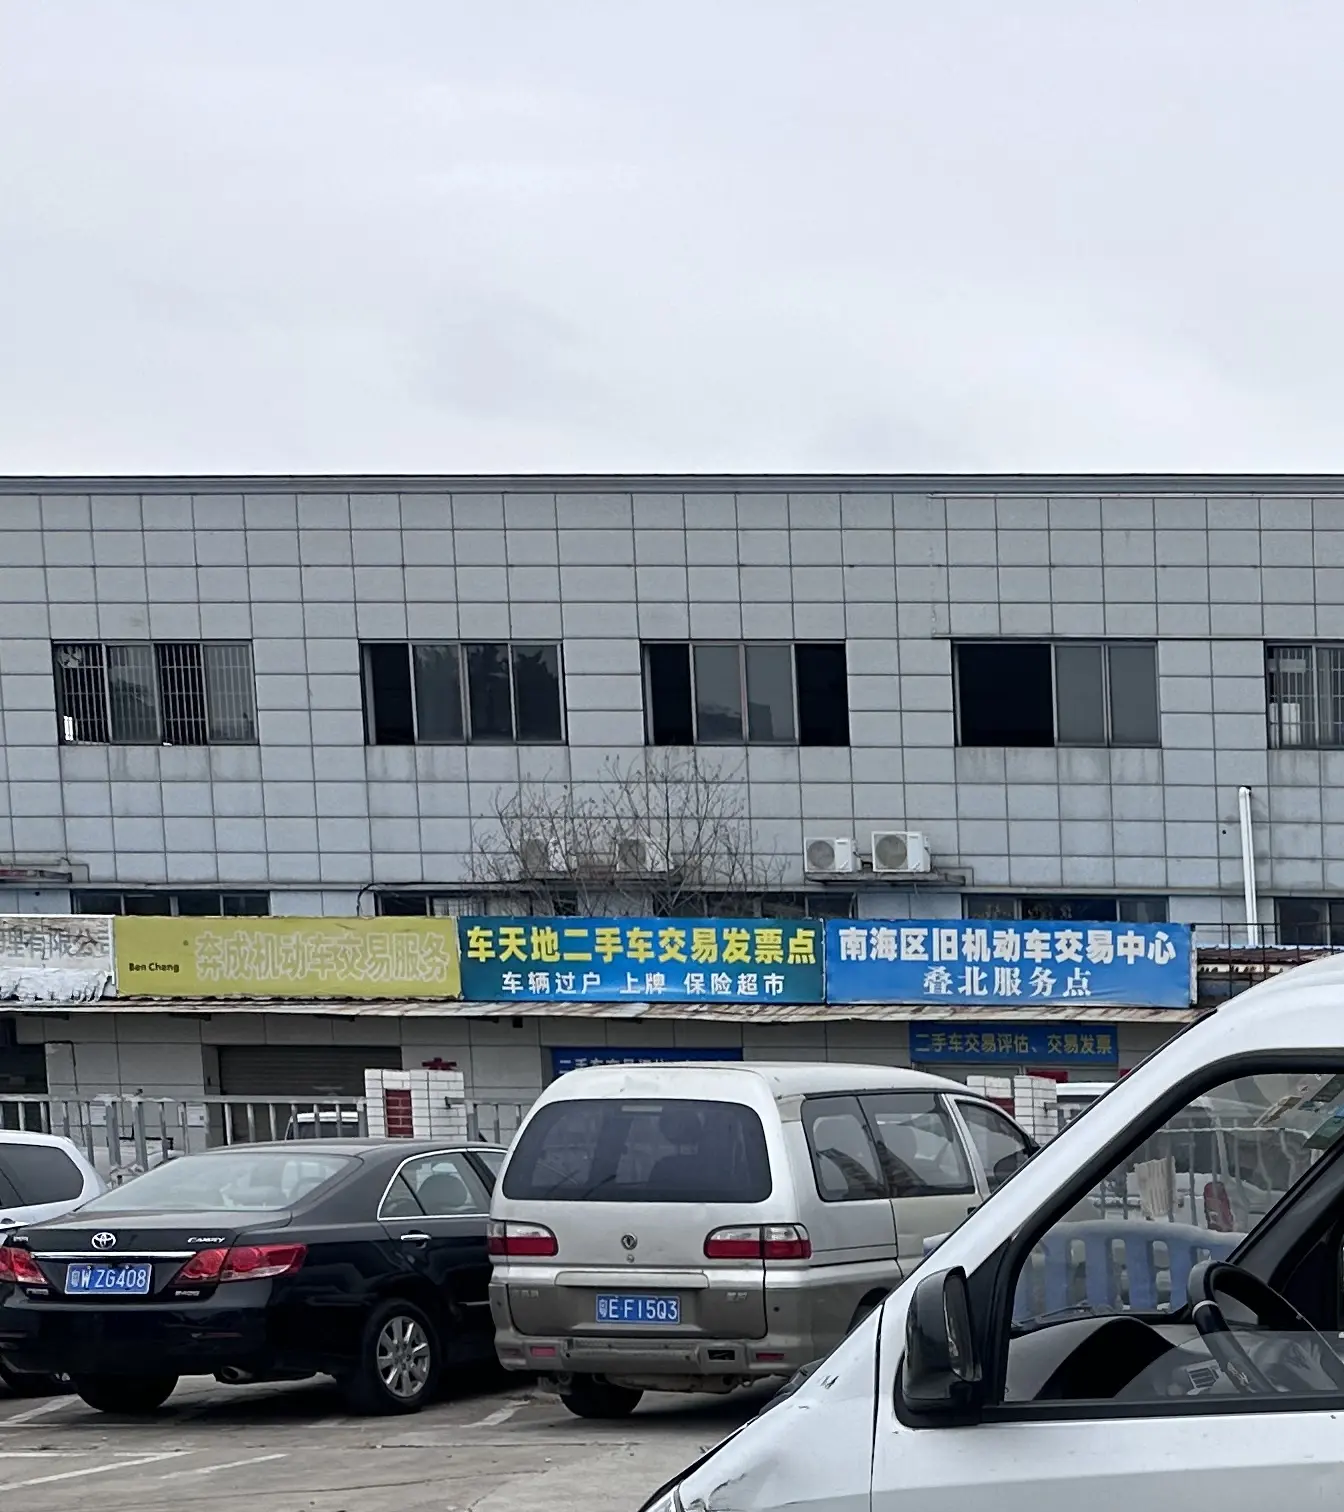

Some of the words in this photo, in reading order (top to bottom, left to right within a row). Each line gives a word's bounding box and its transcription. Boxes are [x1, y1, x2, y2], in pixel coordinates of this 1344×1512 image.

[467, 926, 817, 965] 车天地二手车交易发票点
[838, 926, 1177, 966] 南海区旧机动车交易中心
[501, 971, 602, 996] 车辆过户
[619, 972, 667, 996] 上牌
[683, 972, 786, 997] 保险超市
[923, 966, 1092, 998] 叠北服务点
